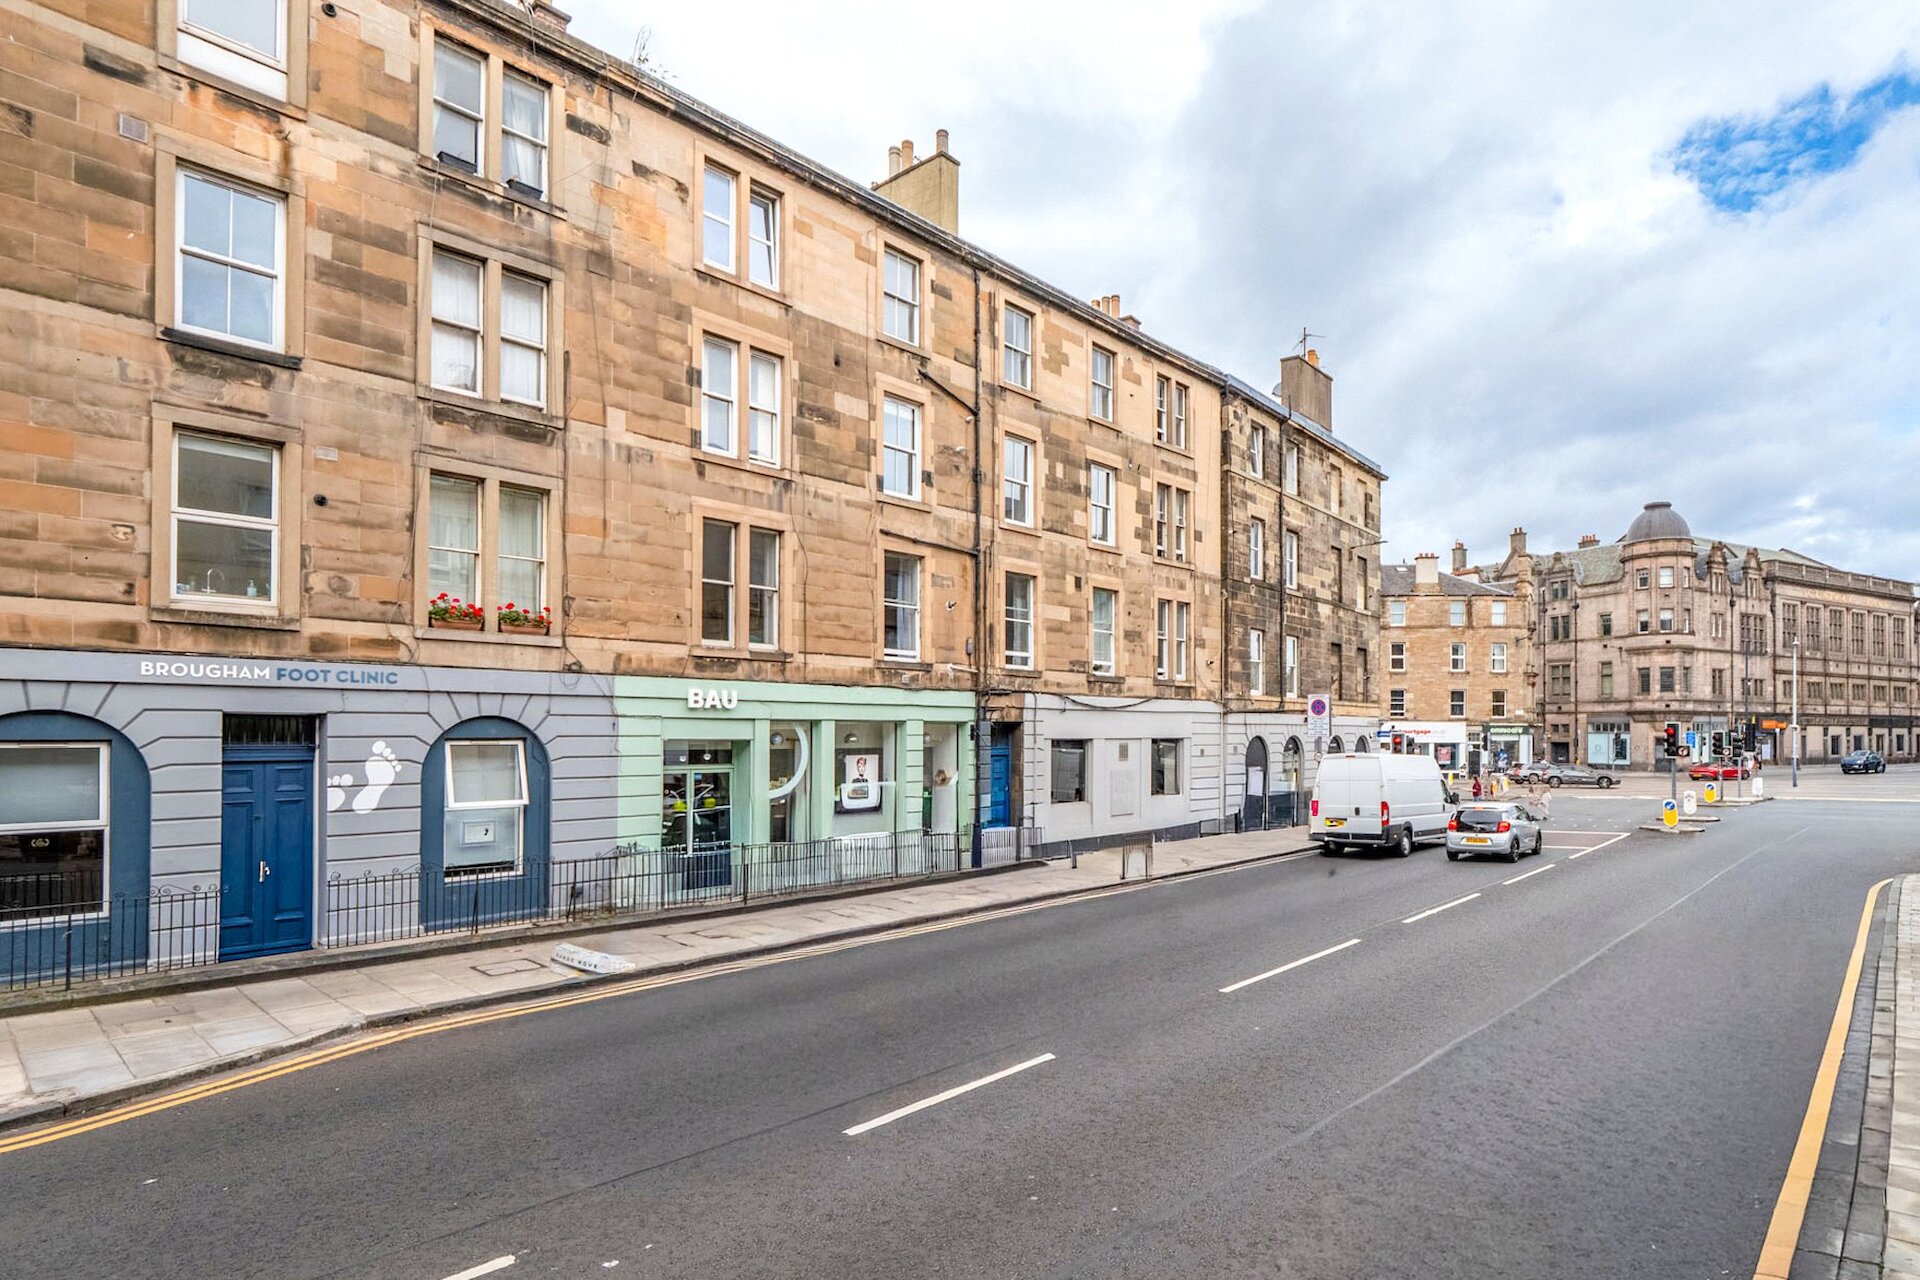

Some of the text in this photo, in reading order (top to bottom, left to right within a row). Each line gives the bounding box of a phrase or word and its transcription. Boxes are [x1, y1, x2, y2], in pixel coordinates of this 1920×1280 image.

[140, 661, 398, 685] BROUGHAM FOOT CLINIC
[687, 689, 738, 709] BAU
